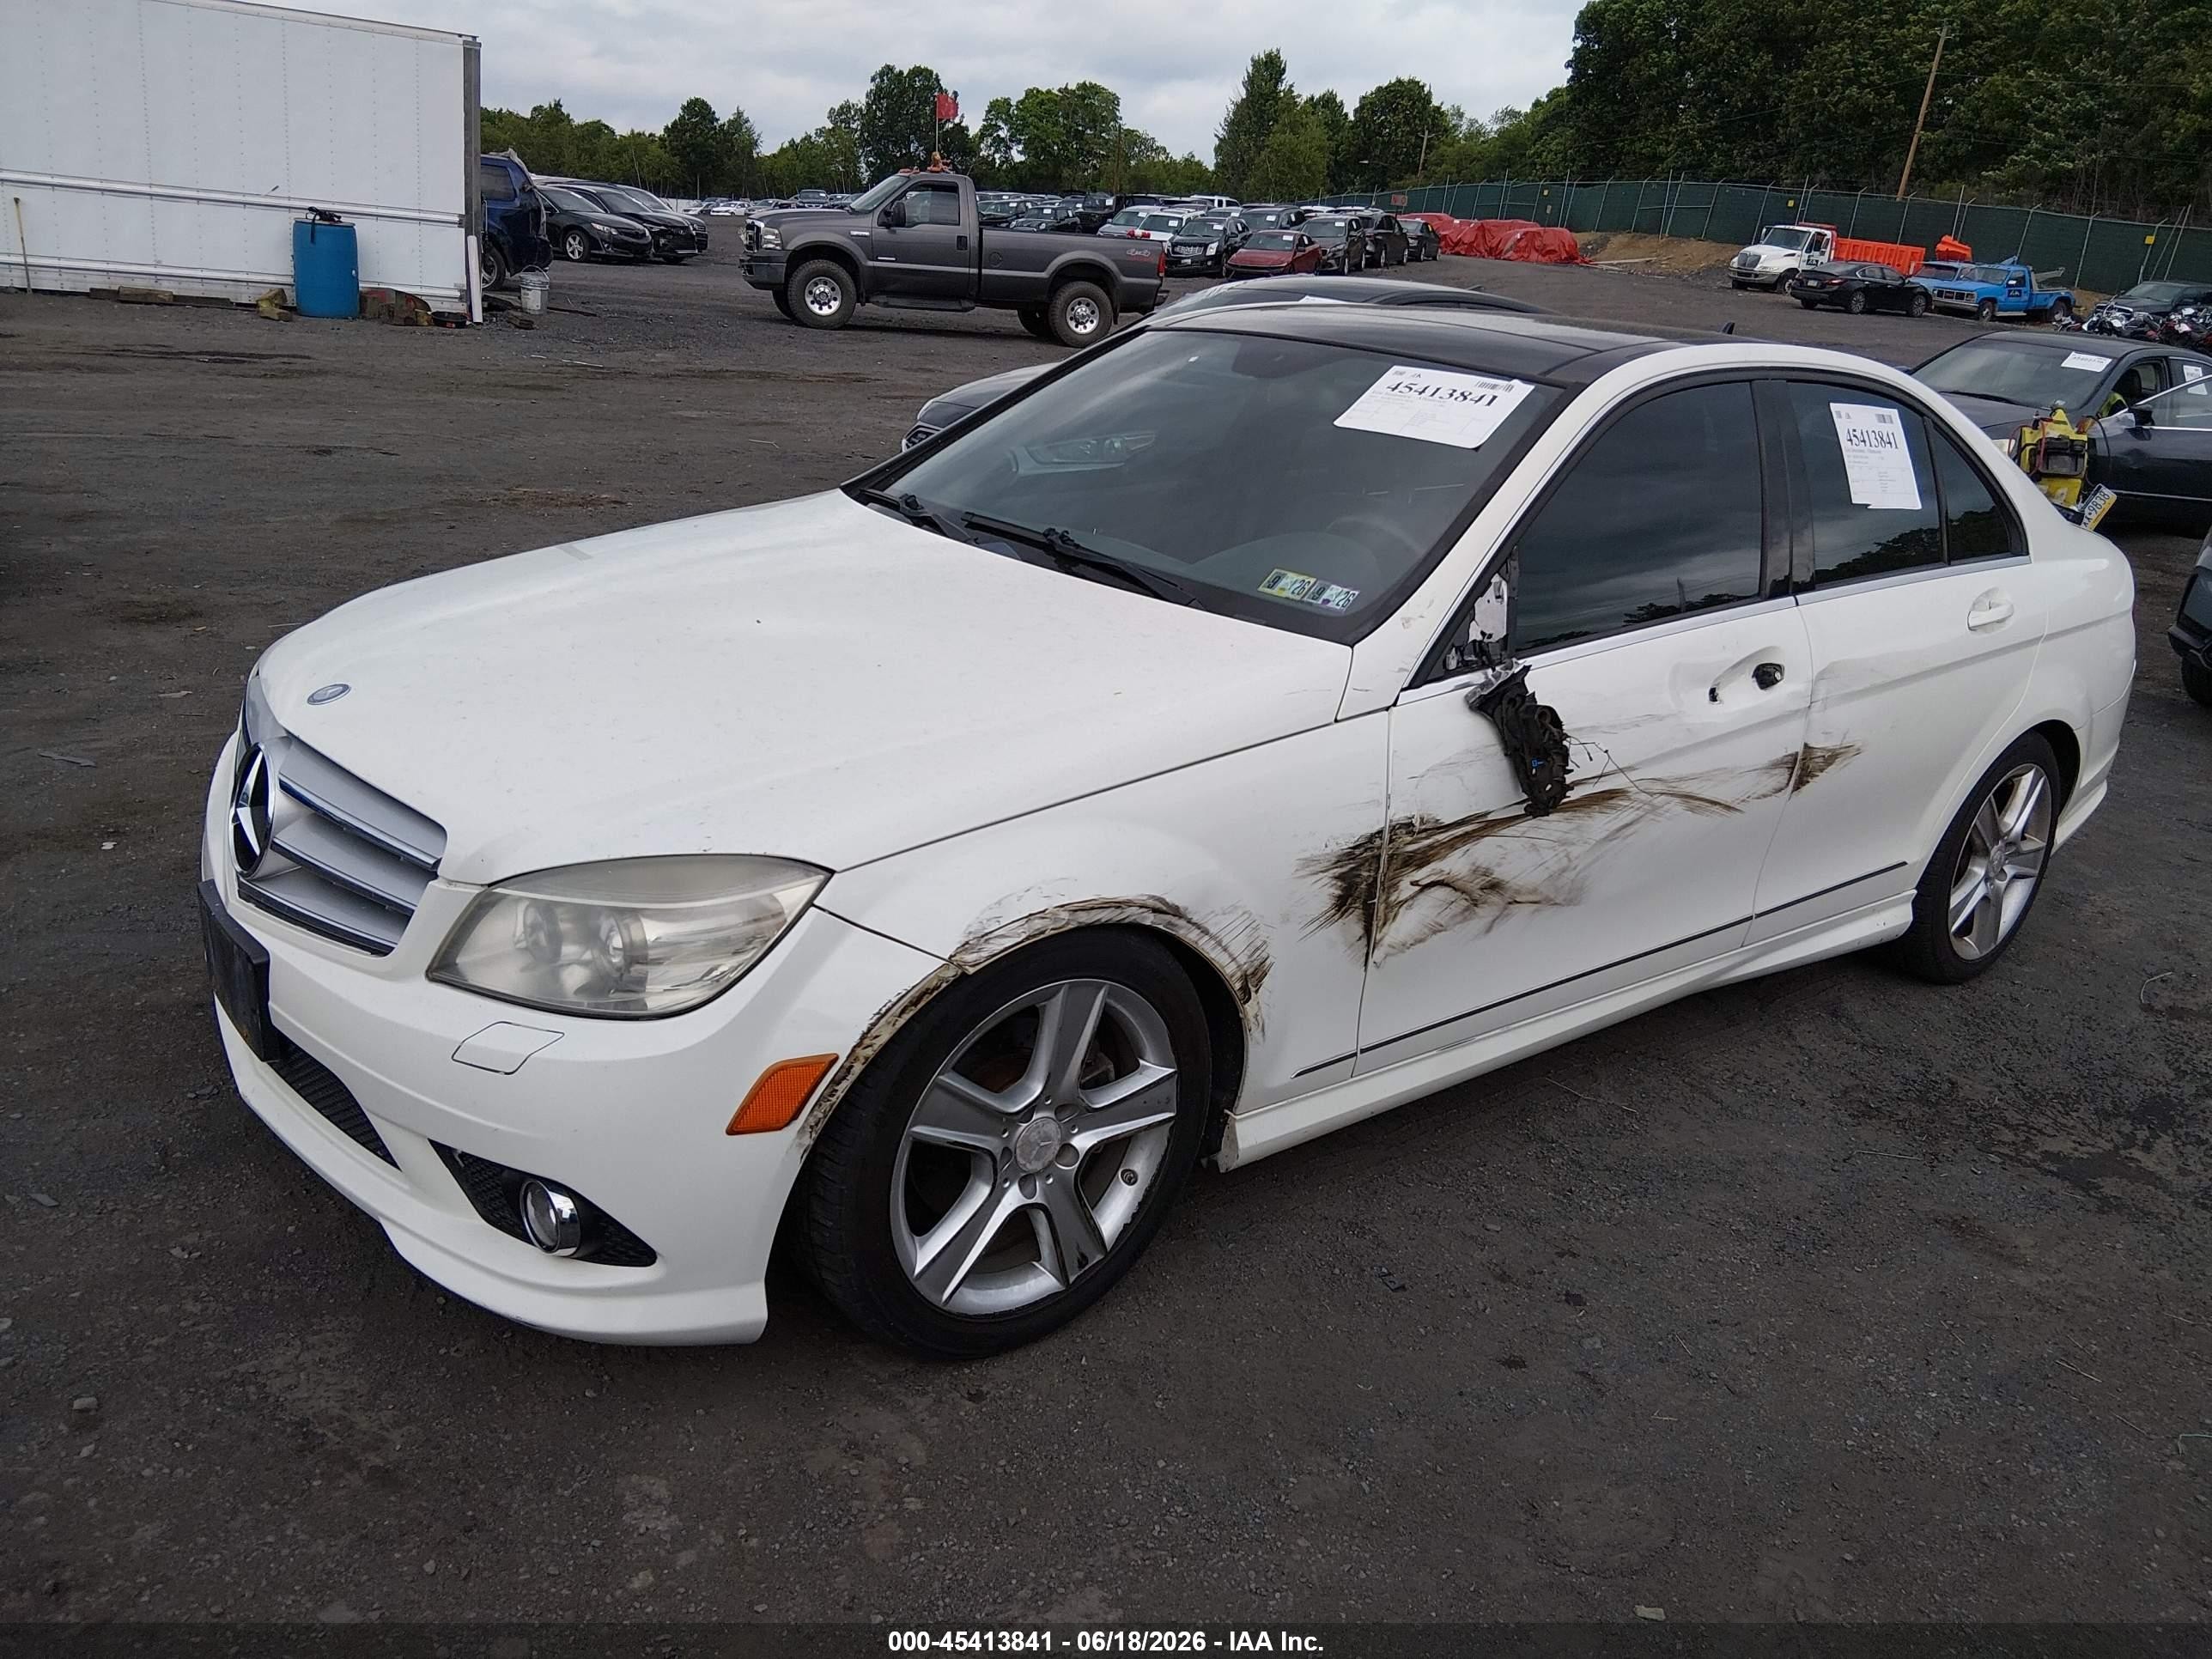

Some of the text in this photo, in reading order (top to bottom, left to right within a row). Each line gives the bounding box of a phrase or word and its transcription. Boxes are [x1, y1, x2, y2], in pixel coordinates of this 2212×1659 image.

[1386, 380, 1498, 407] 45413841
[1846, 428, 1899, 450] 45413841
[1267, 575, 1281, 590] 9
[1312, 586, 1326, 601] 9
